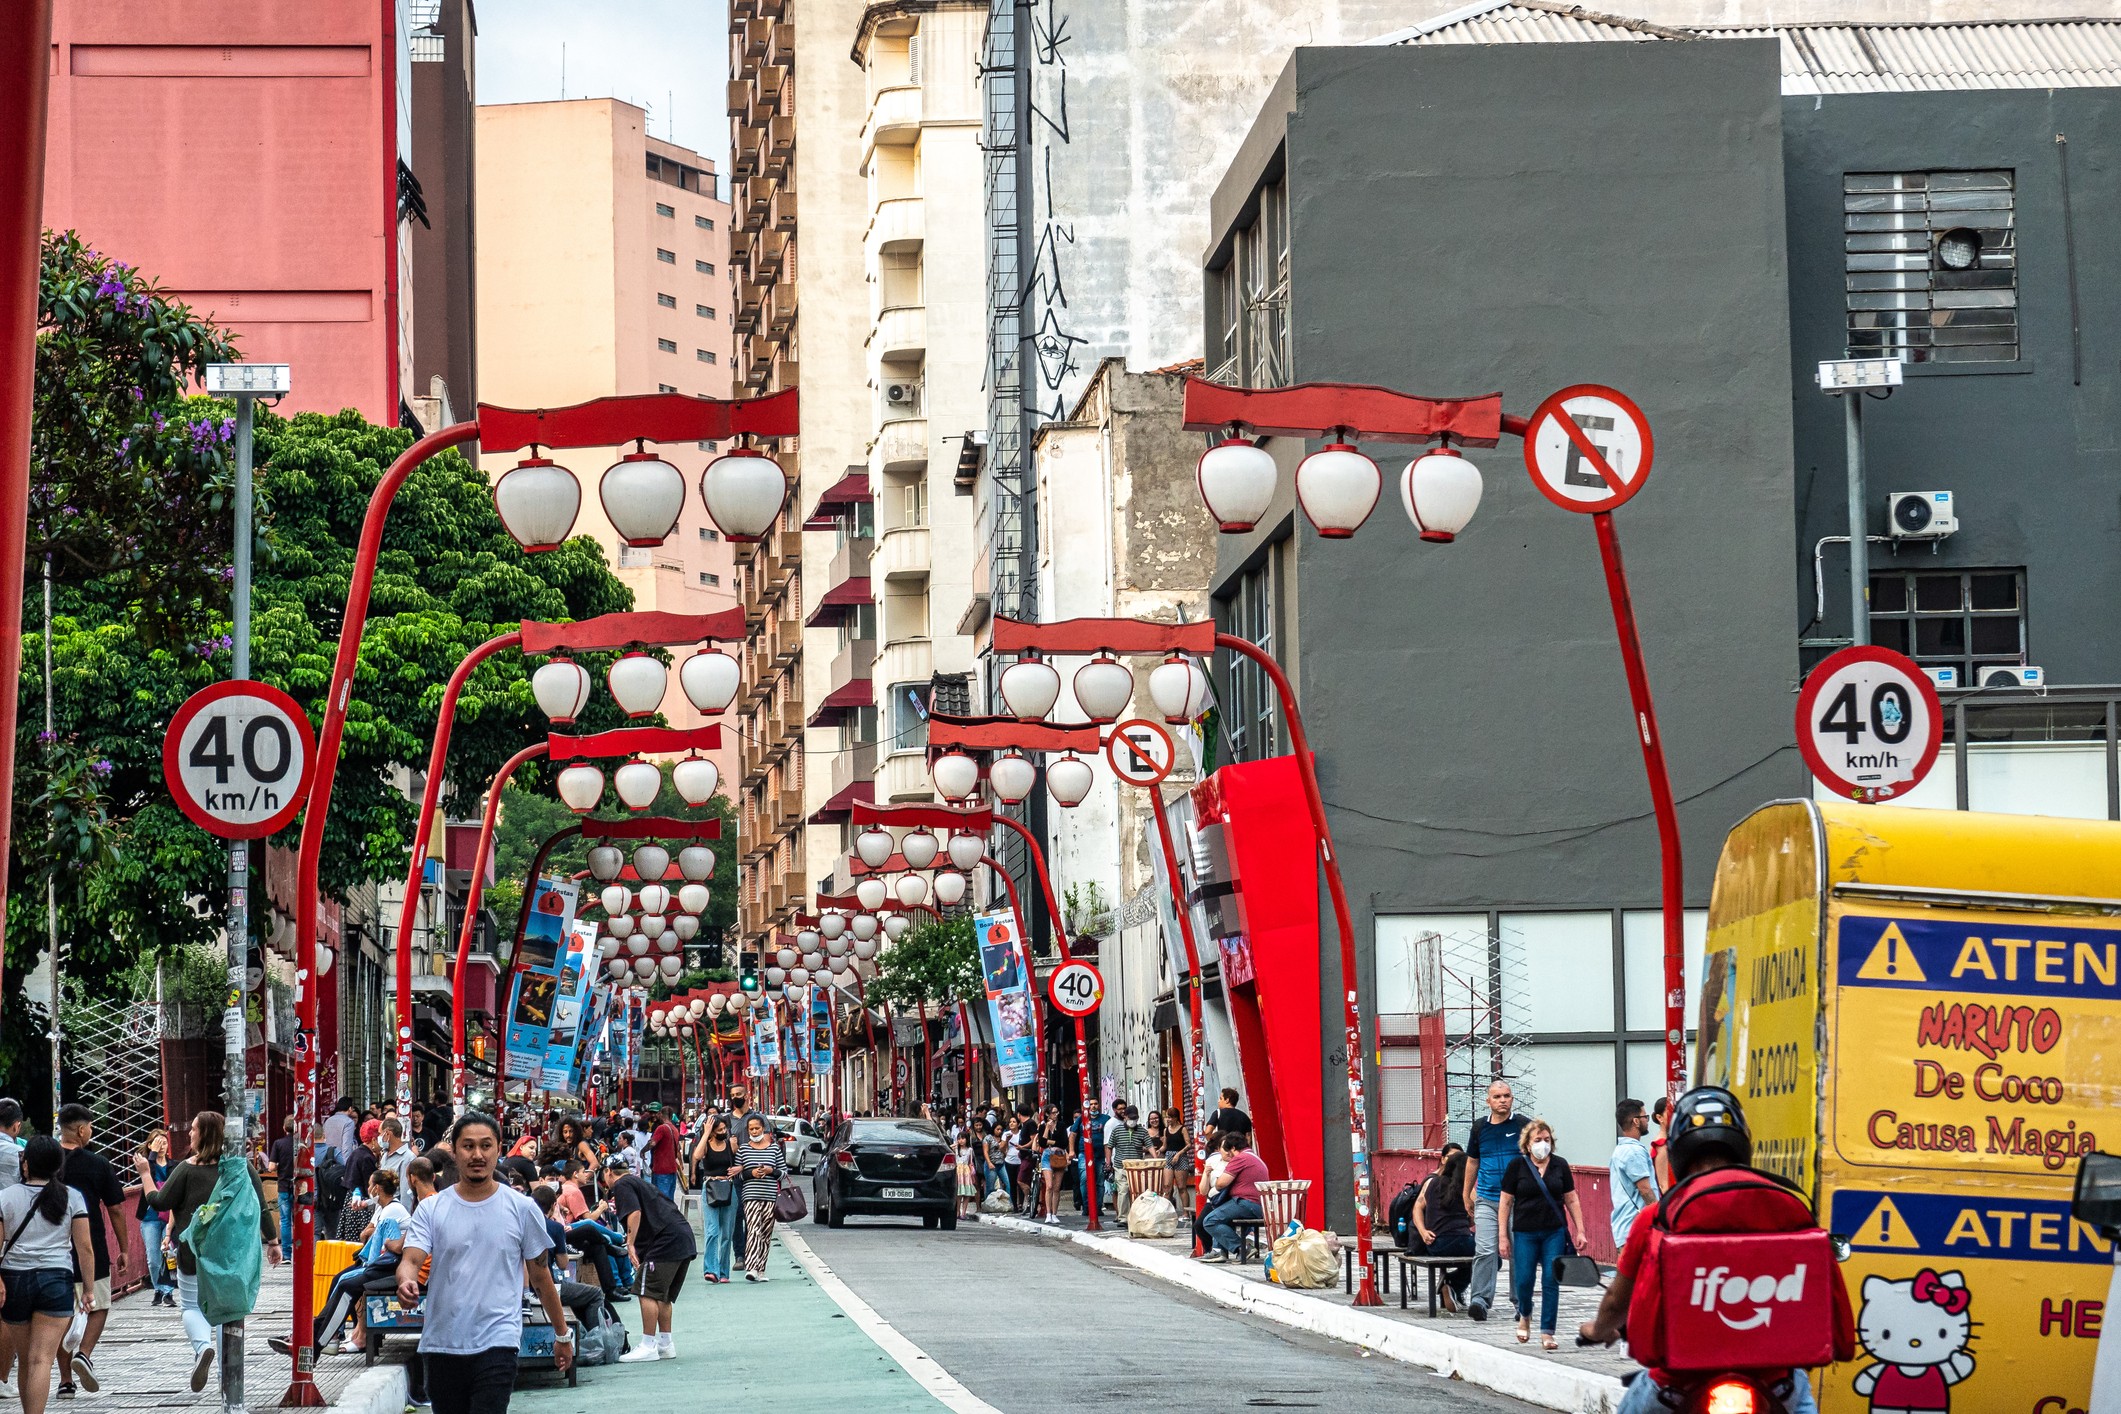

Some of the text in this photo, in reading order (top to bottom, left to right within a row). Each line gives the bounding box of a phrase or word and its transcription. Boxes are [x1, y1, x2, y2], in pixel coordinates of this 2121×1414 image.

[1564, 413, 1615, 489] E
[1819, 682, 1912, 745] 40
[189, 715, 291, 784] 40
[1128, 734, 1153, 772] E
[1846, 751, 1899, 769] km/h
[205, 786, 279, 812] km/h
[1751, 945, 1807, 1007] LIMONADA
[1951, 937, 2117, 985] ATEN
[1058, 972, 1094, 998] 40
[1065, 997, 1085, 1006] km/h
[1918, 1001, 2062, 1060] NARUTO
[1750, 1041, 1799, 1099] DE COCO
[1913, 1059, 2064, 1105] De Coco
[1867, 1110, 1977, 1153] Causa
[1944, 1209, 2112, 1253] ATEN
[1690, 1264, 1808, 1312] ifood
